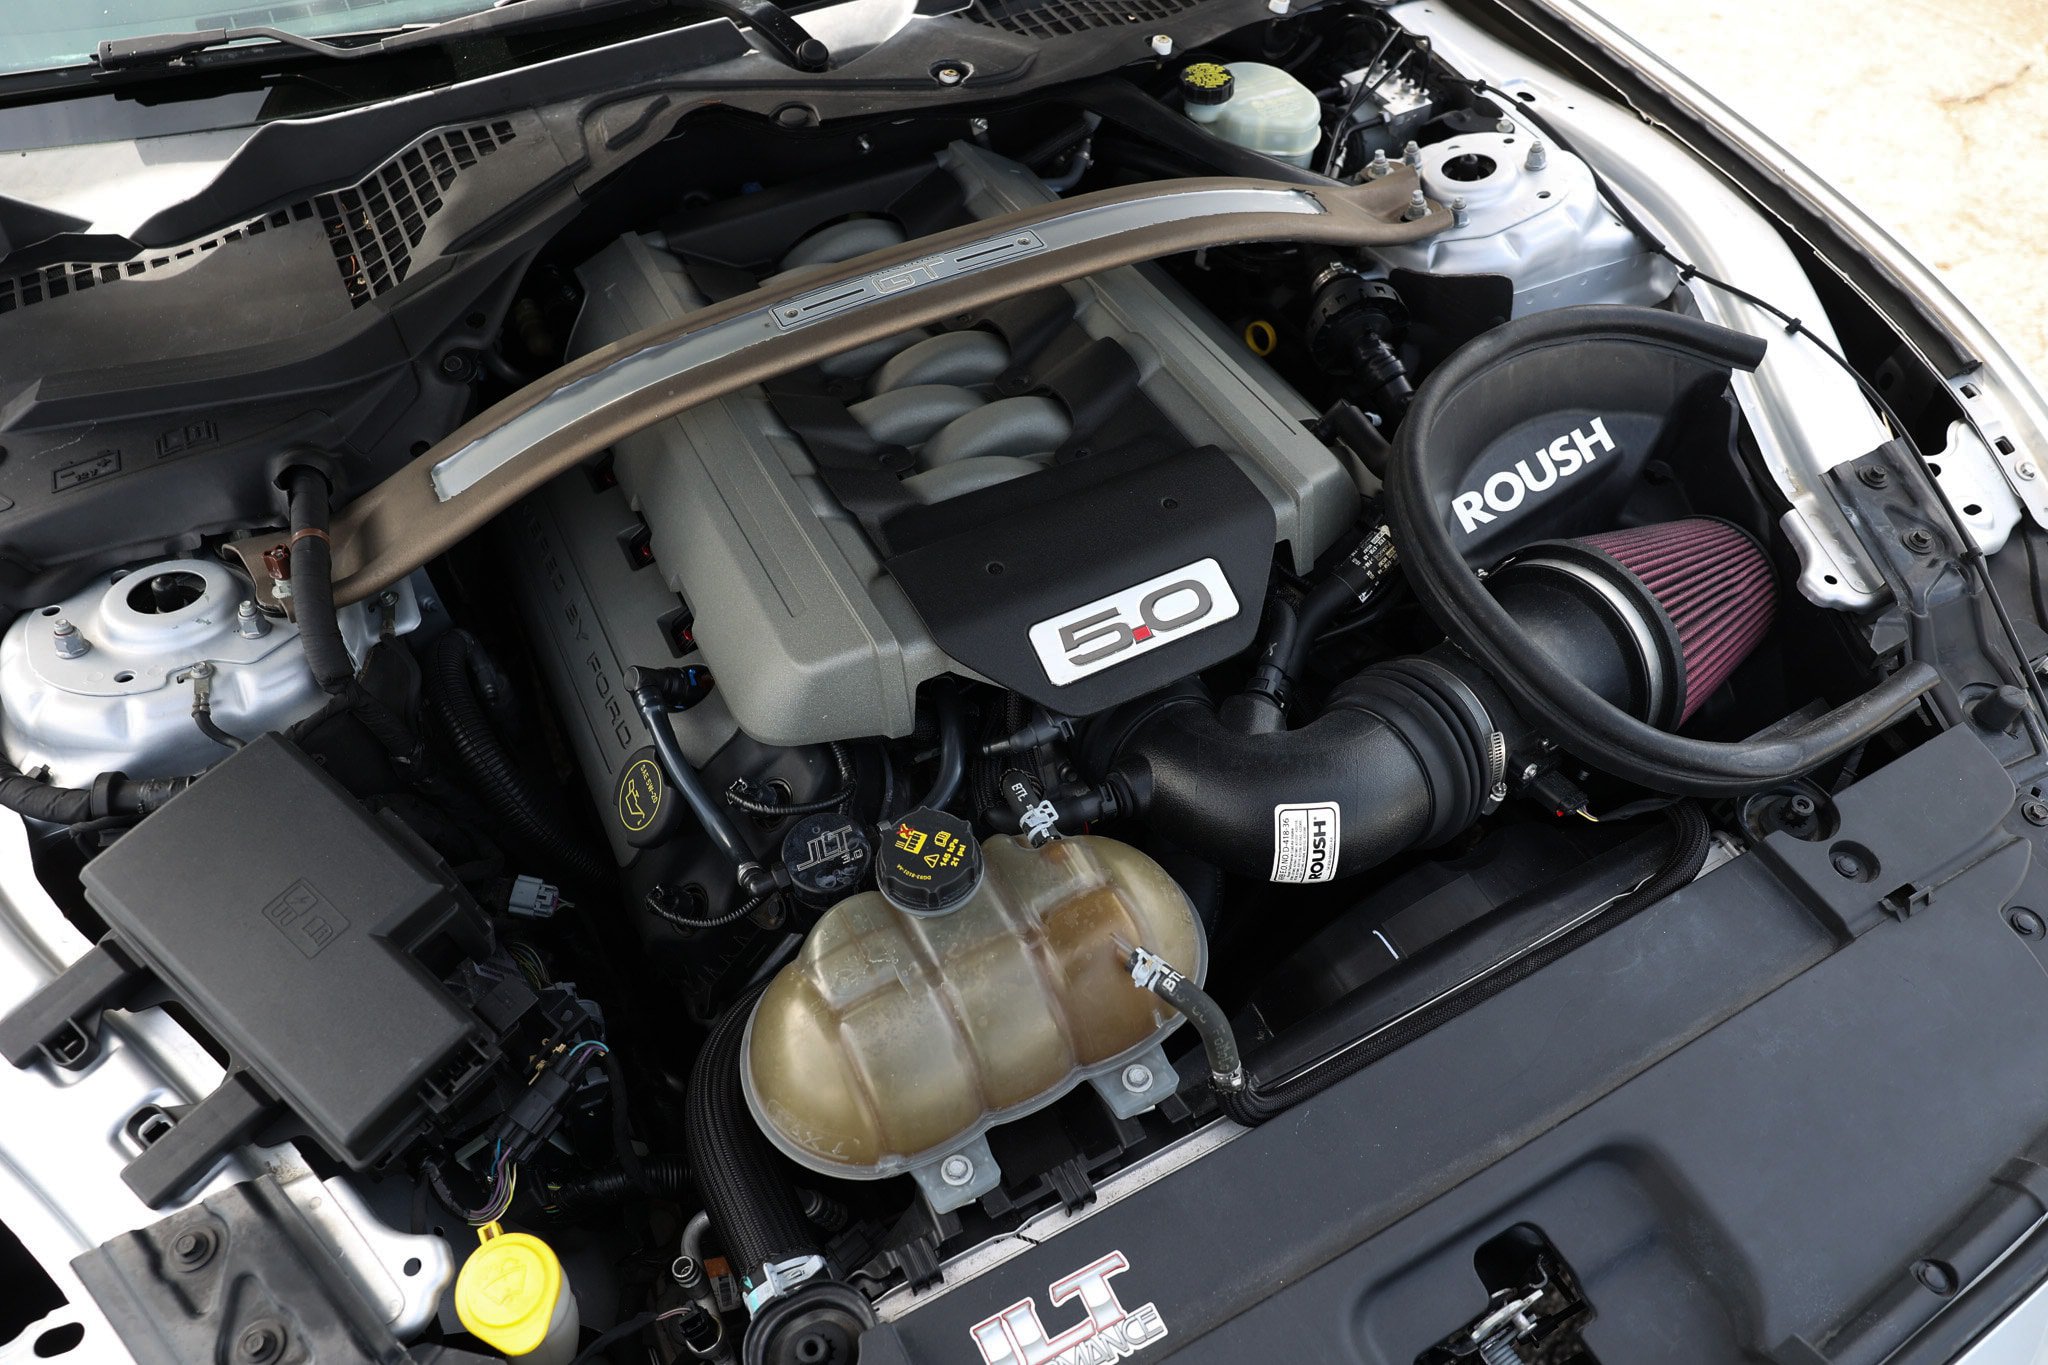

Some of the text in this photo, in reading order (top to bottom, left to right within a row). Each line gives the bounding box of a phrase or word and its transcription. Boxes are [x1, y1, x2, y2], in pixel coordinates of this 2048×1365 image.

[871, 256, 945, 295] GT
[1451, 416, 1616, 534] ROUSH
[1058, 579, 1213, 667] 5.0
[563, 599, 590, 642] BY
[585, 650, 633, 750] FORD
[796, 824, 854, 872] JLT
[938, 837, 960, 867] 145 kPa
[950, 857, 961, 868] 21
[1308, 820, 1326, 880] ROUSH
